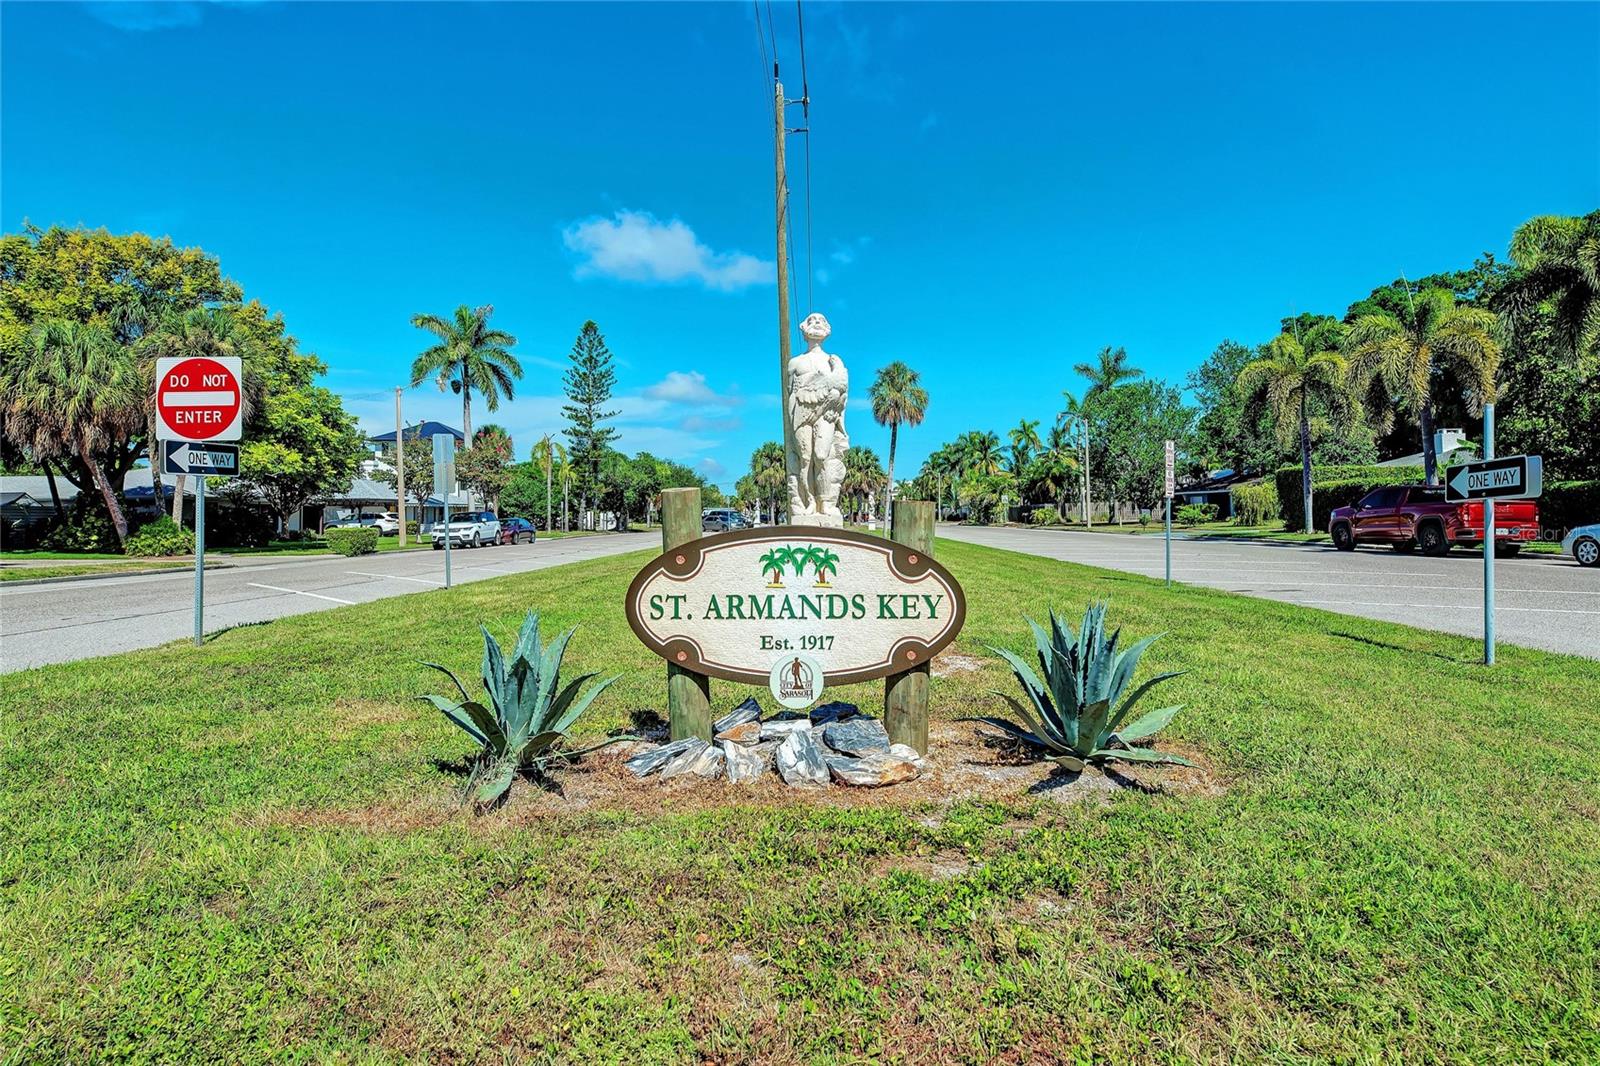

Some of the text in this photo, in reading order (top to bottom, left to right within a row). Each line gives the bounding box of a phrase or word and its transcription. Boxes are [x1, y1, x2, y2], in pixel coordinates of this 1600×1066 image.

[170, 374, 228, 388] DO NOT
[175, 410, 222, 424] ENTER
[188, 452, 231, 466] ONE WAY
[1468, 469, 1517, 489] ONE WAY
[650, 594, 945, 620] ST. ARMANDS KEY
[759, 635, 835, 650] Est. 1917
